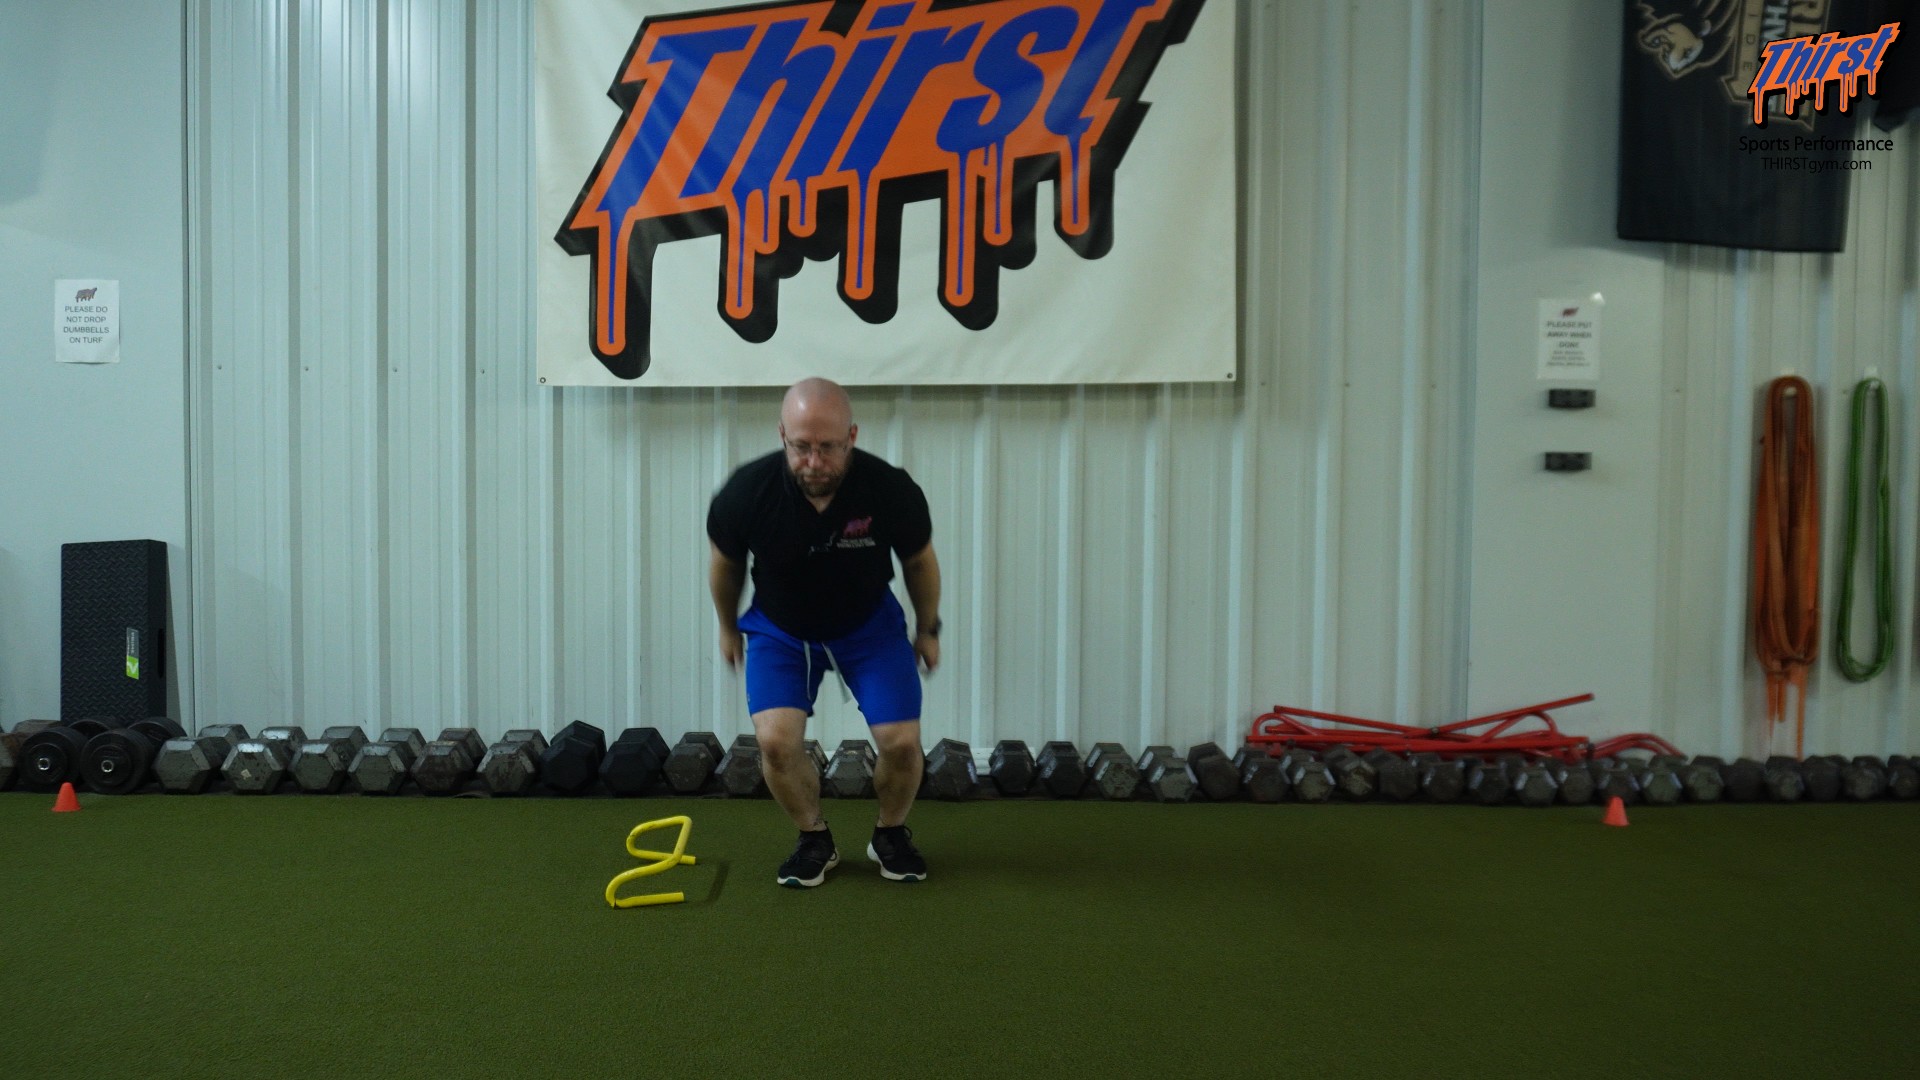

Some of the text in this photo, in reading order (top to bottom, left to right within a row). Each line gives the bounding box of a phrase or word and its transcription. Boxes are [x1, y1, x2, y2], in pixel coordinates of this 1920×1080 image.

[570, 0, 1178, 335] Thirst
[64, 305, 108, 313] PLEASE DO
[1547, 320, 1576, 328] PLEASE
[63, 326, 110, 334] DUMBBELLS
[69, 336, 103, 344] ON TURF
